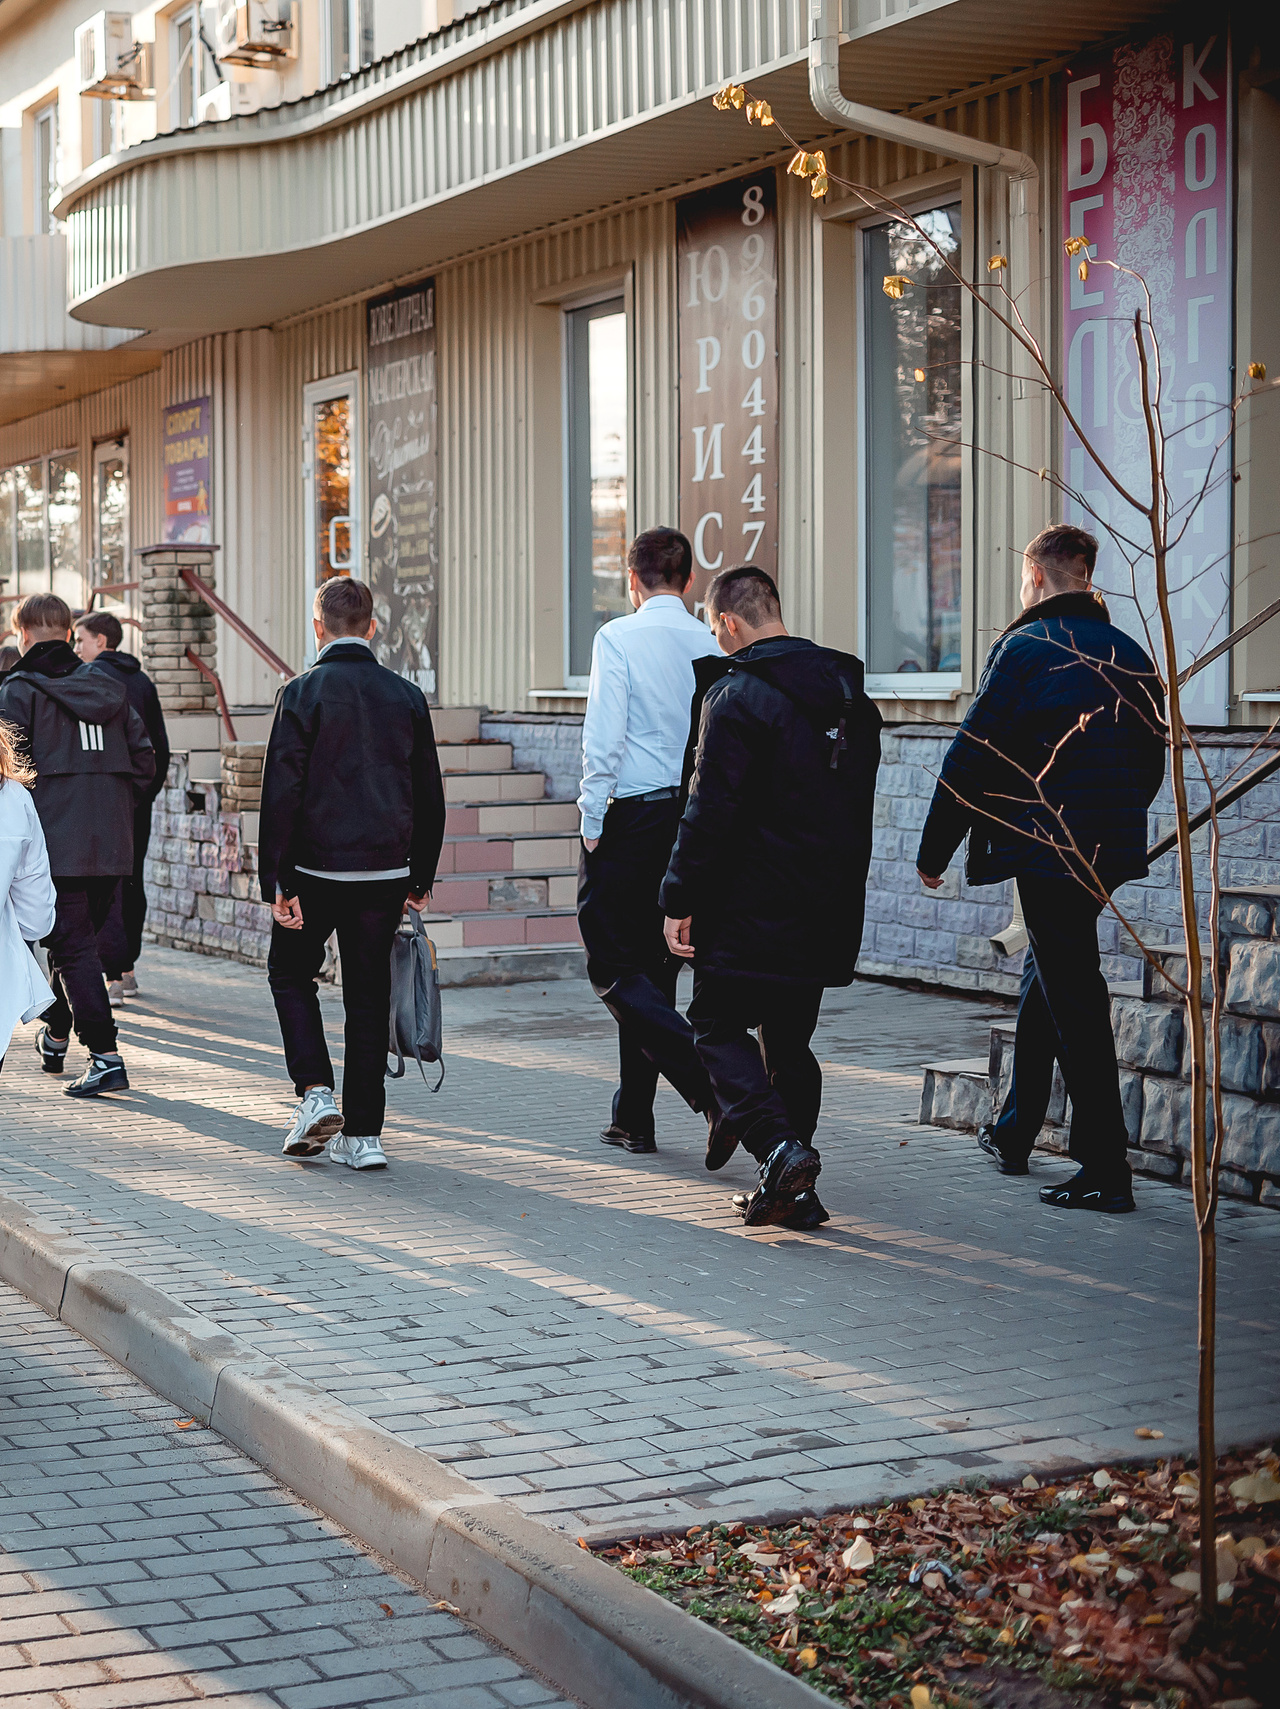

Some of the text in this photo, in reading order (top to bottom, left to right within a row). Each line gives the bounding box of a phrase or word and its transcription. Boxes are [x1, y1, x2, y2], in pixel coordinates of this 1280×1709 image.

[164, 434, 209, 466] ТОВАРЫ
[165, 405, 201, 436] СПОРТ
[1067, 73, 1109, 586] БЕЛЬ
[1181, 35, 1220, 705] КОЛГОТКИ
